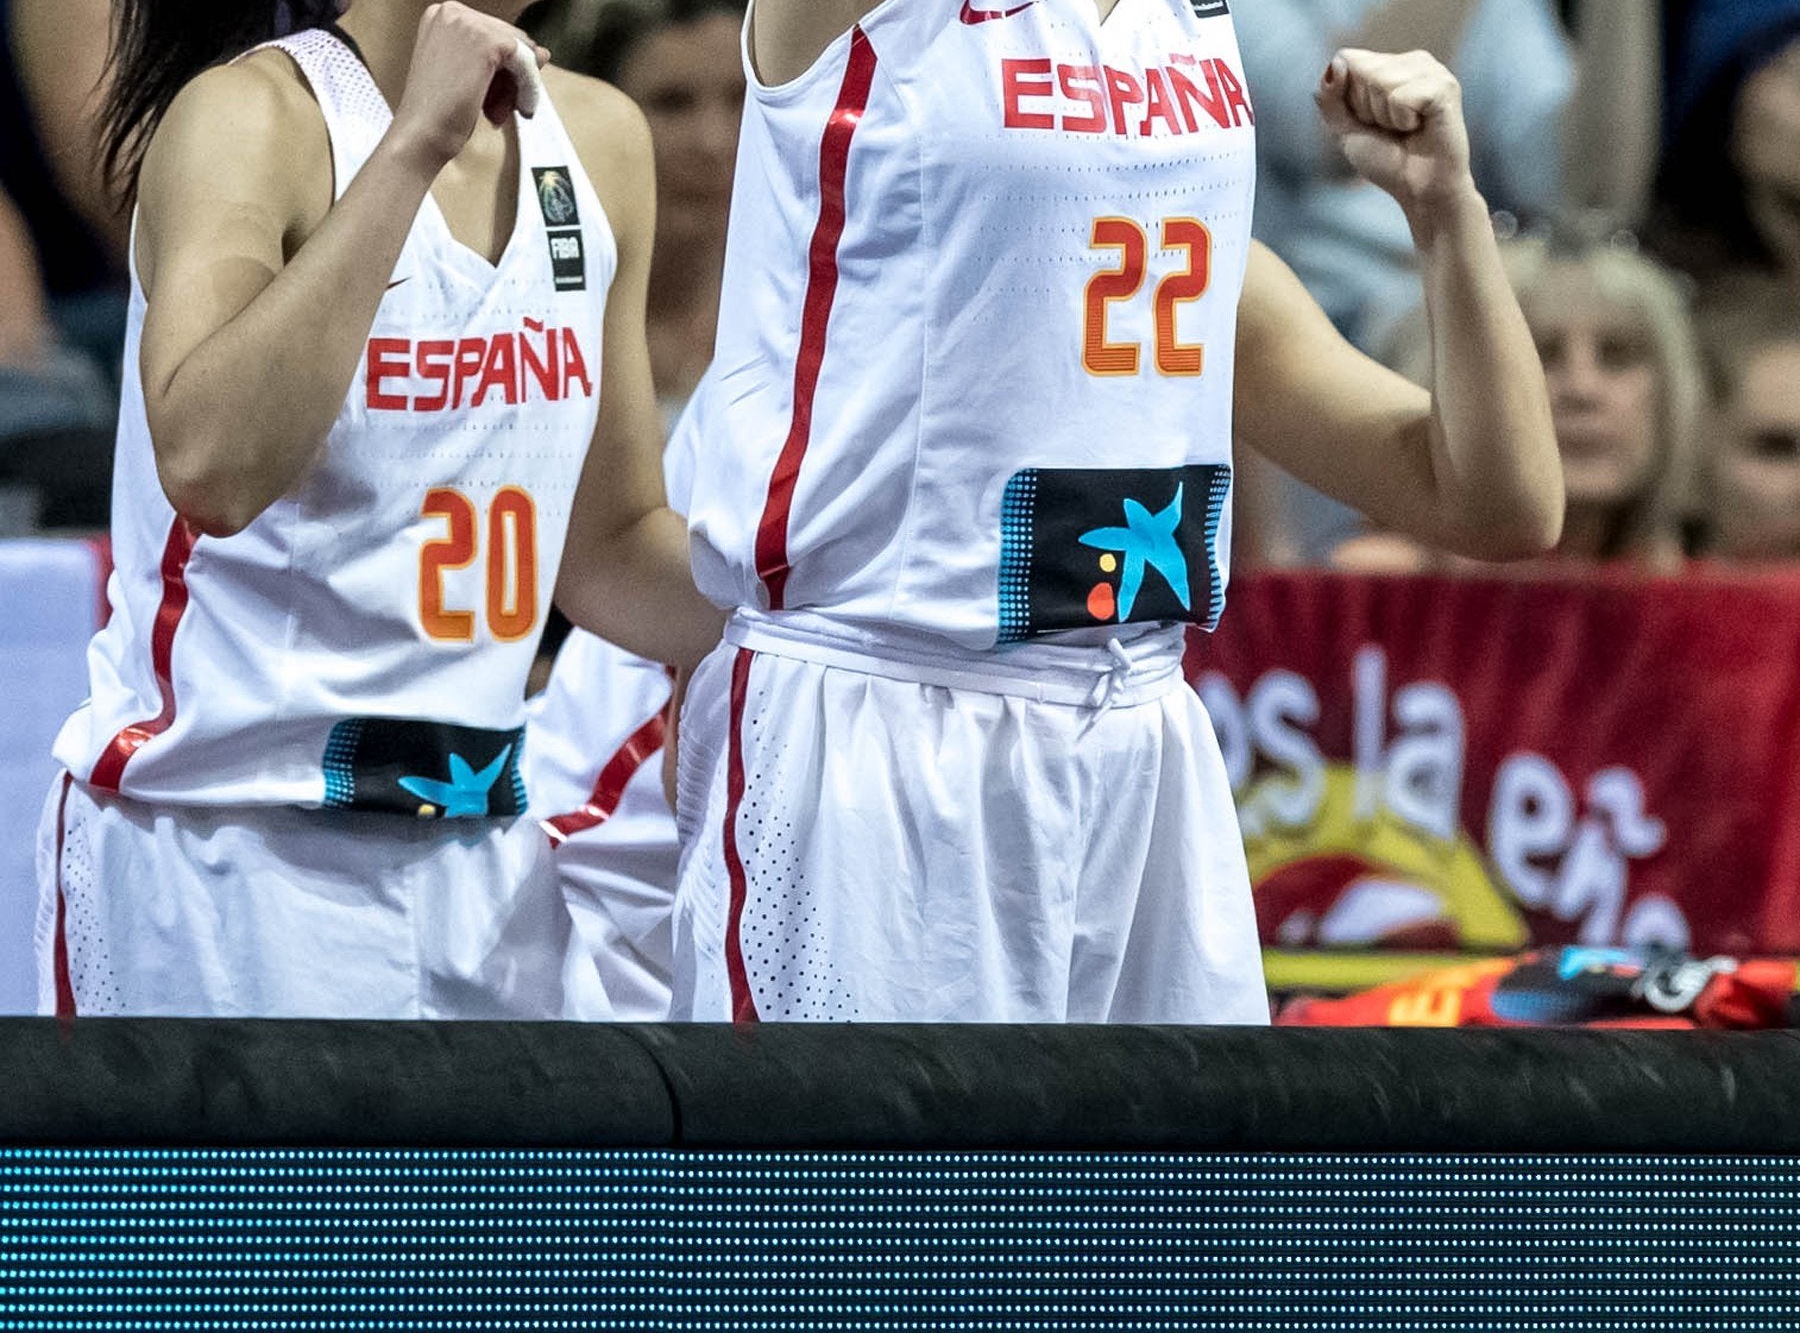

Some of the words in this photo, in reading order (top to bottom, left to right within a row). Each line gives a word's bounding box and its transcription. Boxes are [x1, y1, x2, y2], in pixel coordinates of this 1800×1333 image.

[1001, 53, 1255, 137] ESPAÑA
[549, 235, 581, 260] FIBA
[1081, 215, 1212, 378] 22
[365, 315, 593, 412] ESPAÑA
[418, 483, 539, 643] 20
[1352, 642, 1466, 839] la
